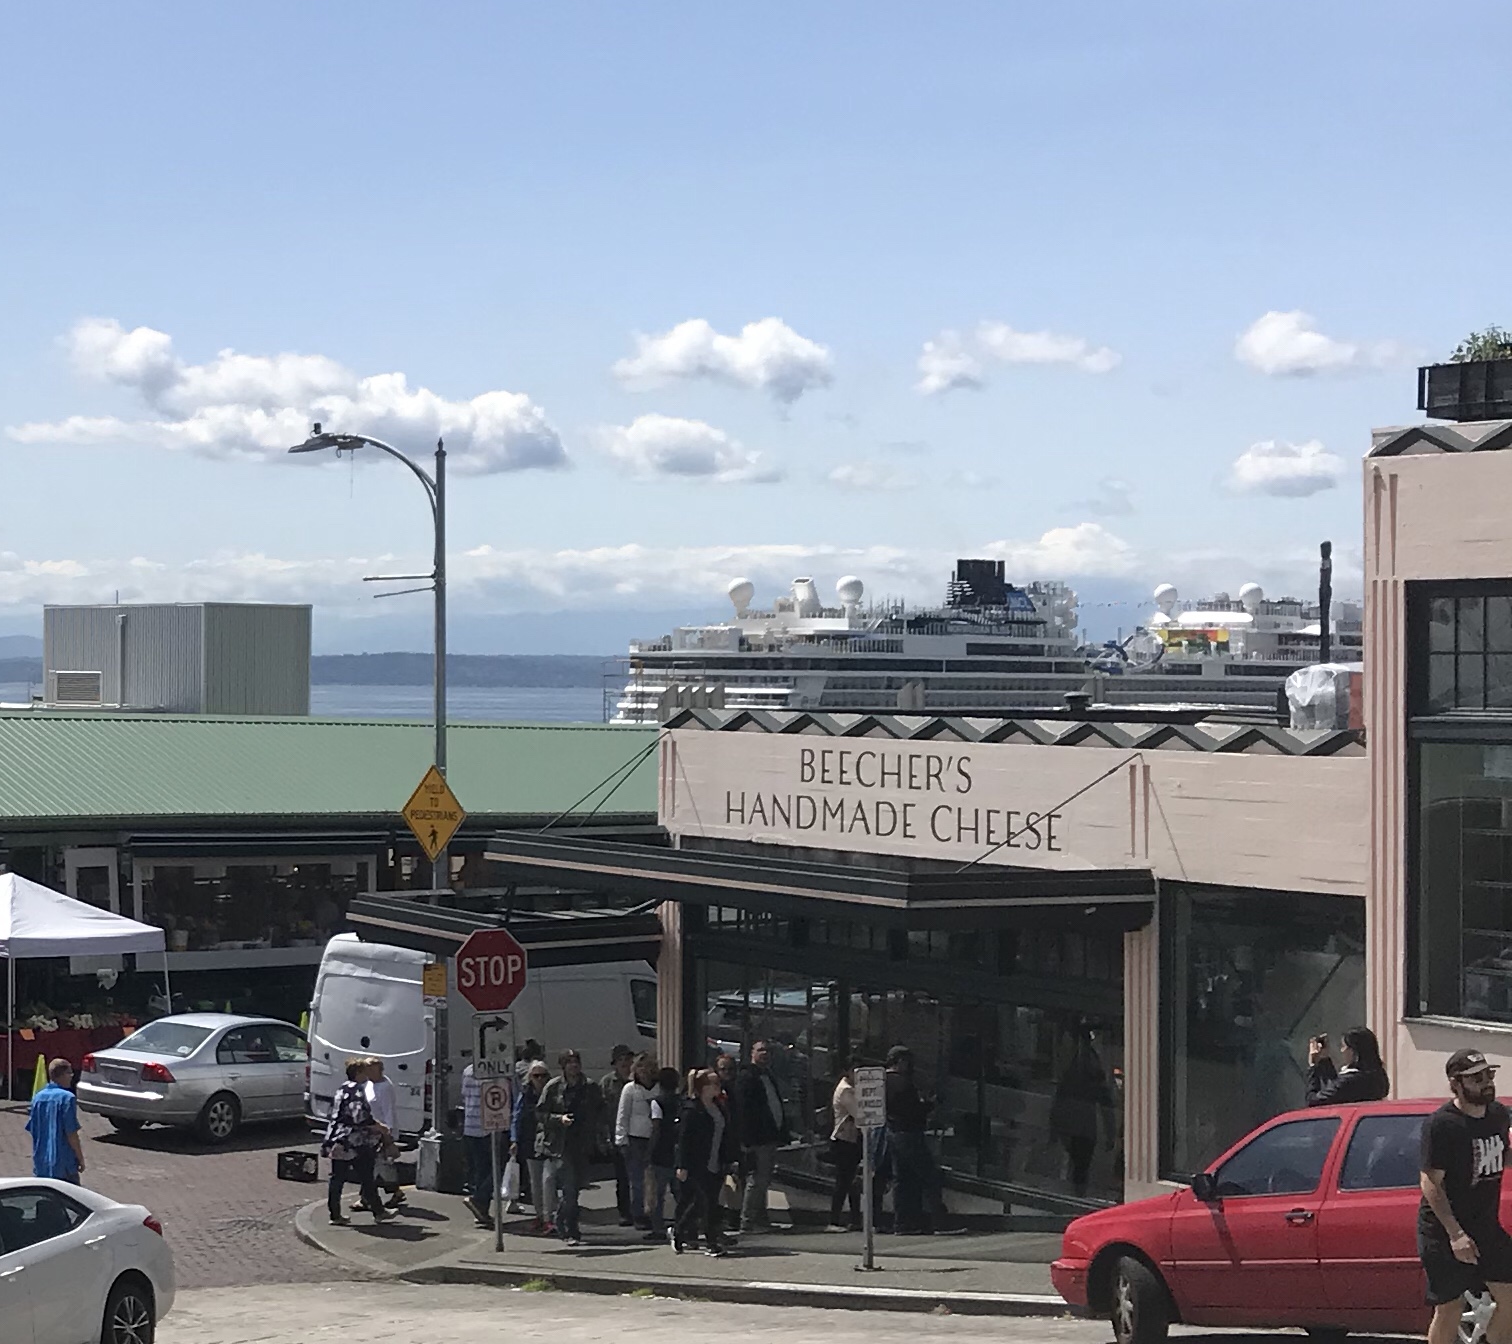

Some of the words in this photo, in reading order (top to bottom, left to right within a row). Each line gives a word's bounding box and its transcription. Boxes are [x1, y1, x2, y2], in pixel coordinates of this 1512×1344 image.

[800, 748, 973, 794] BEECHER'S
[725, 790, 918, 839] HANDMADE
[930, 804, 1063, 852] CHEESE
[460, 954, 522, 988] STOP
[477, 1060, 513, 1075] ONLY
